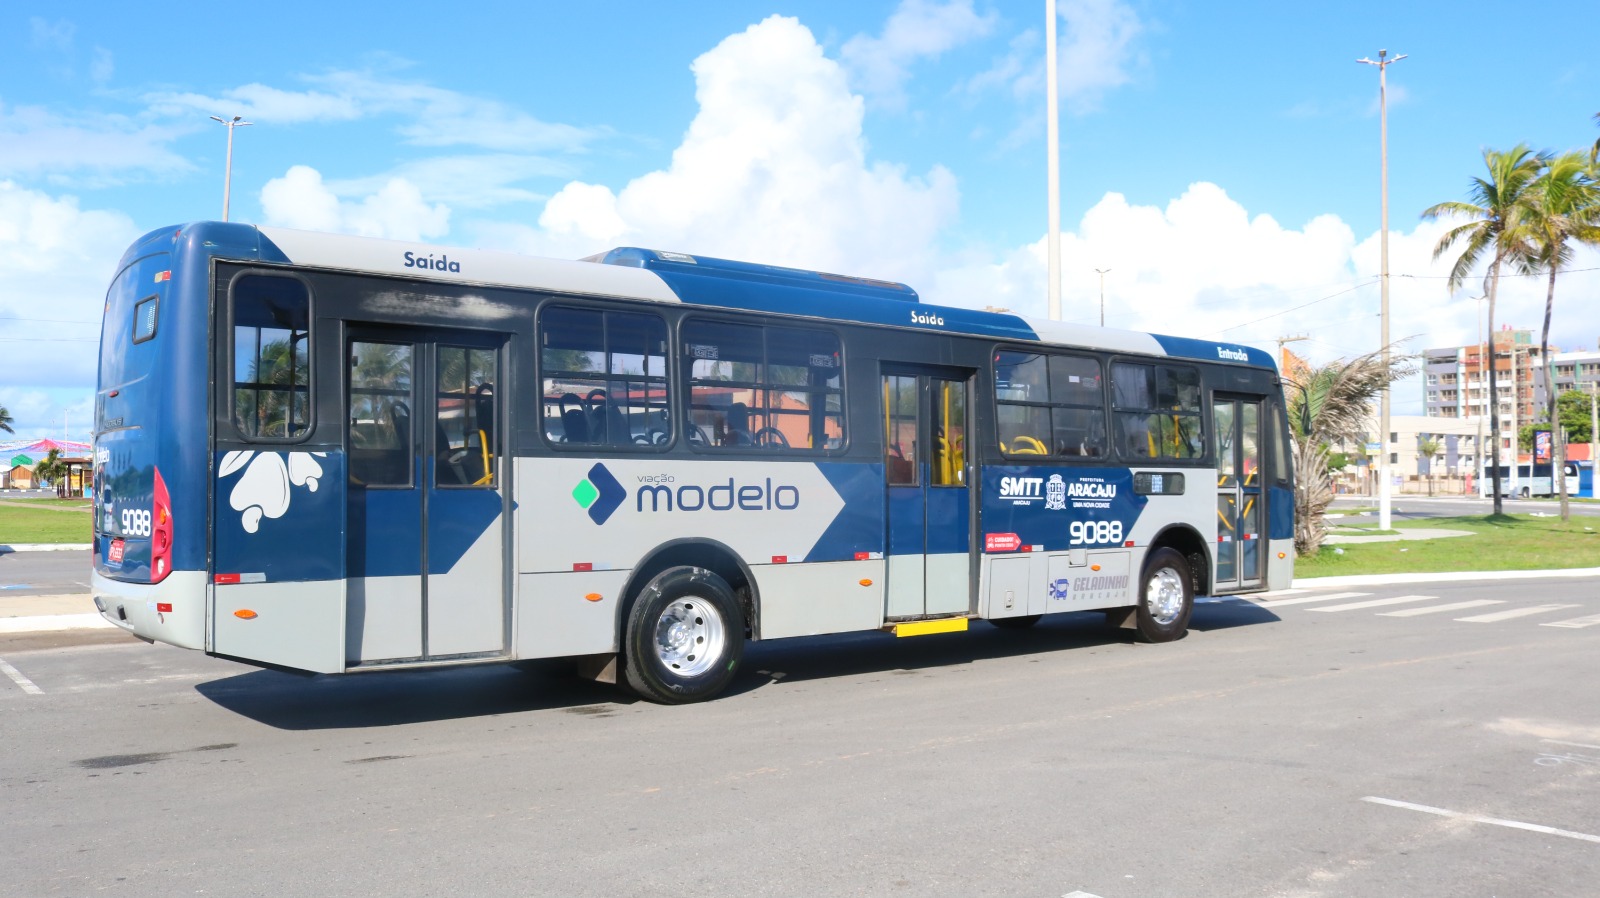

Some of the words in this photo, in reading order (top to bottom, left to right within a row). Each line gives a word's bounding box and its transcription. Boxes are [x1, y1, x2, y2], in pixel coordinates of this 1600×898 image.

[403, 251, 461, 273] Saída
[1216, 346, 1249, 362] Entrada
[637, 473, 675, 485] viação
[999, 477, 1043, 496] SMTT
[636, 477, 800, 512] modelo
[1067, 483, 1117, 498] ARACAJU
[121, 508, 152, 537] 9088
[1069, 520, 1123, 545] 9088
[1073, 575, 1129, 592] GELADINHO
